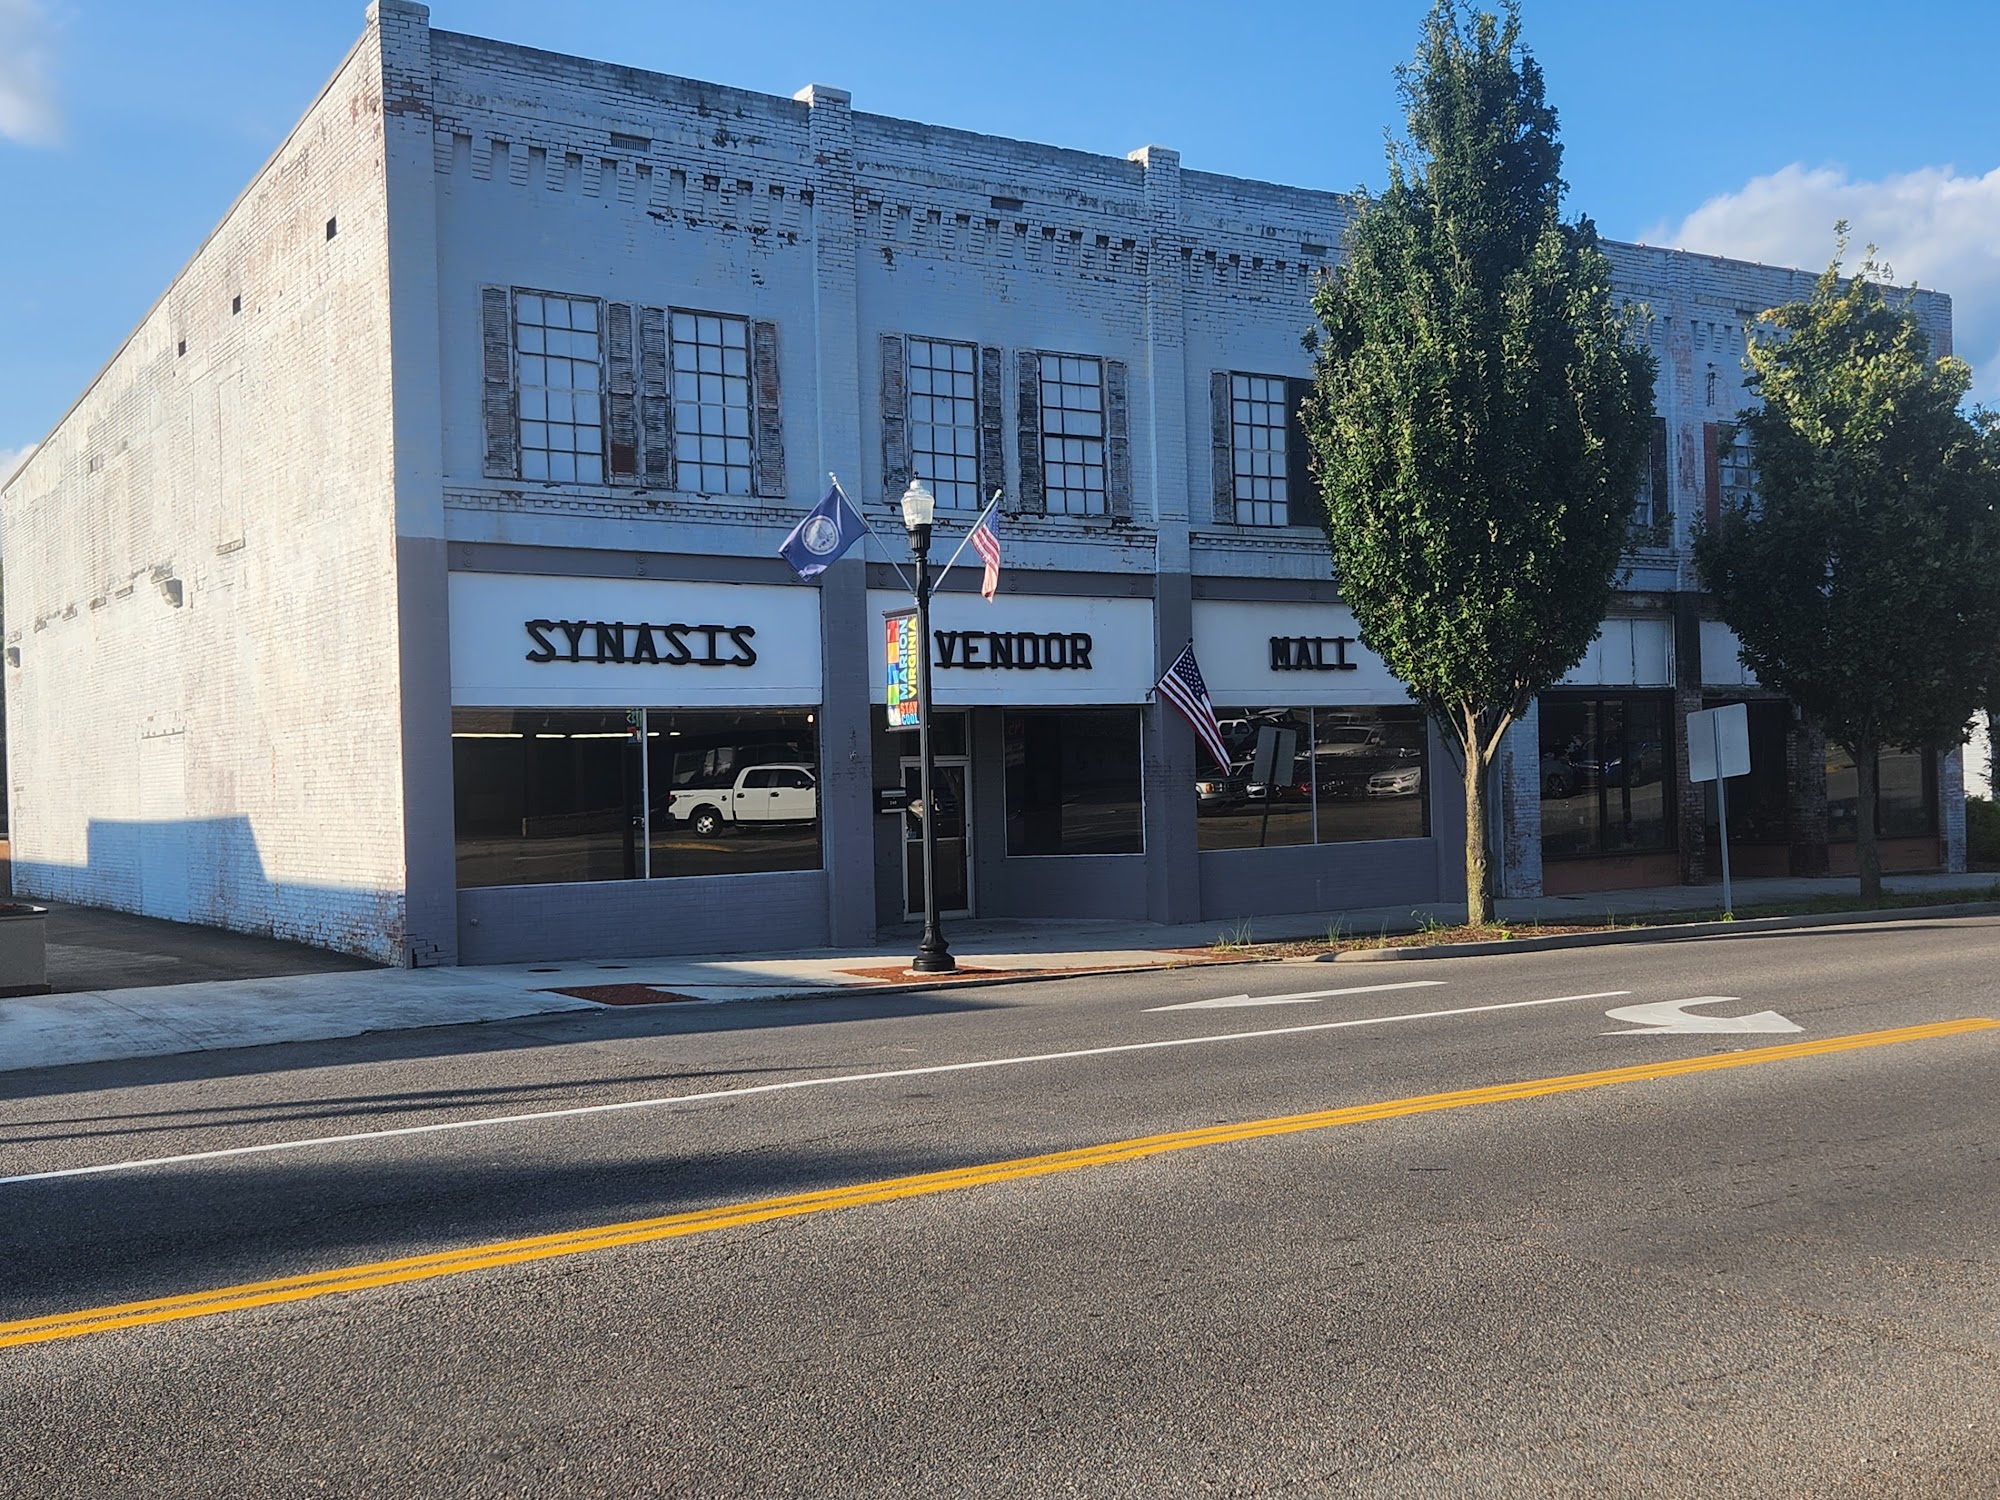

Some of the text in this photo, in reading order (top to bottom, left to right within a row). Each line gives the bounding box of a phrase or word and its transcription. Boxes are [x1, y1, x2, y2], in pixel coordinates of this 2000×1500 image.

[525, 619, 757, 667] SYNASIS
[899, 619, 908, 700] MARION
[907, 617, 917, 699] VIRGINIA
[934, 630, 1093, 670] VENDOR
[1270, 636, 1358, 671] MALL
[900, 701, 918, 714] STAY
[902, 713, 920, 725] COOL
